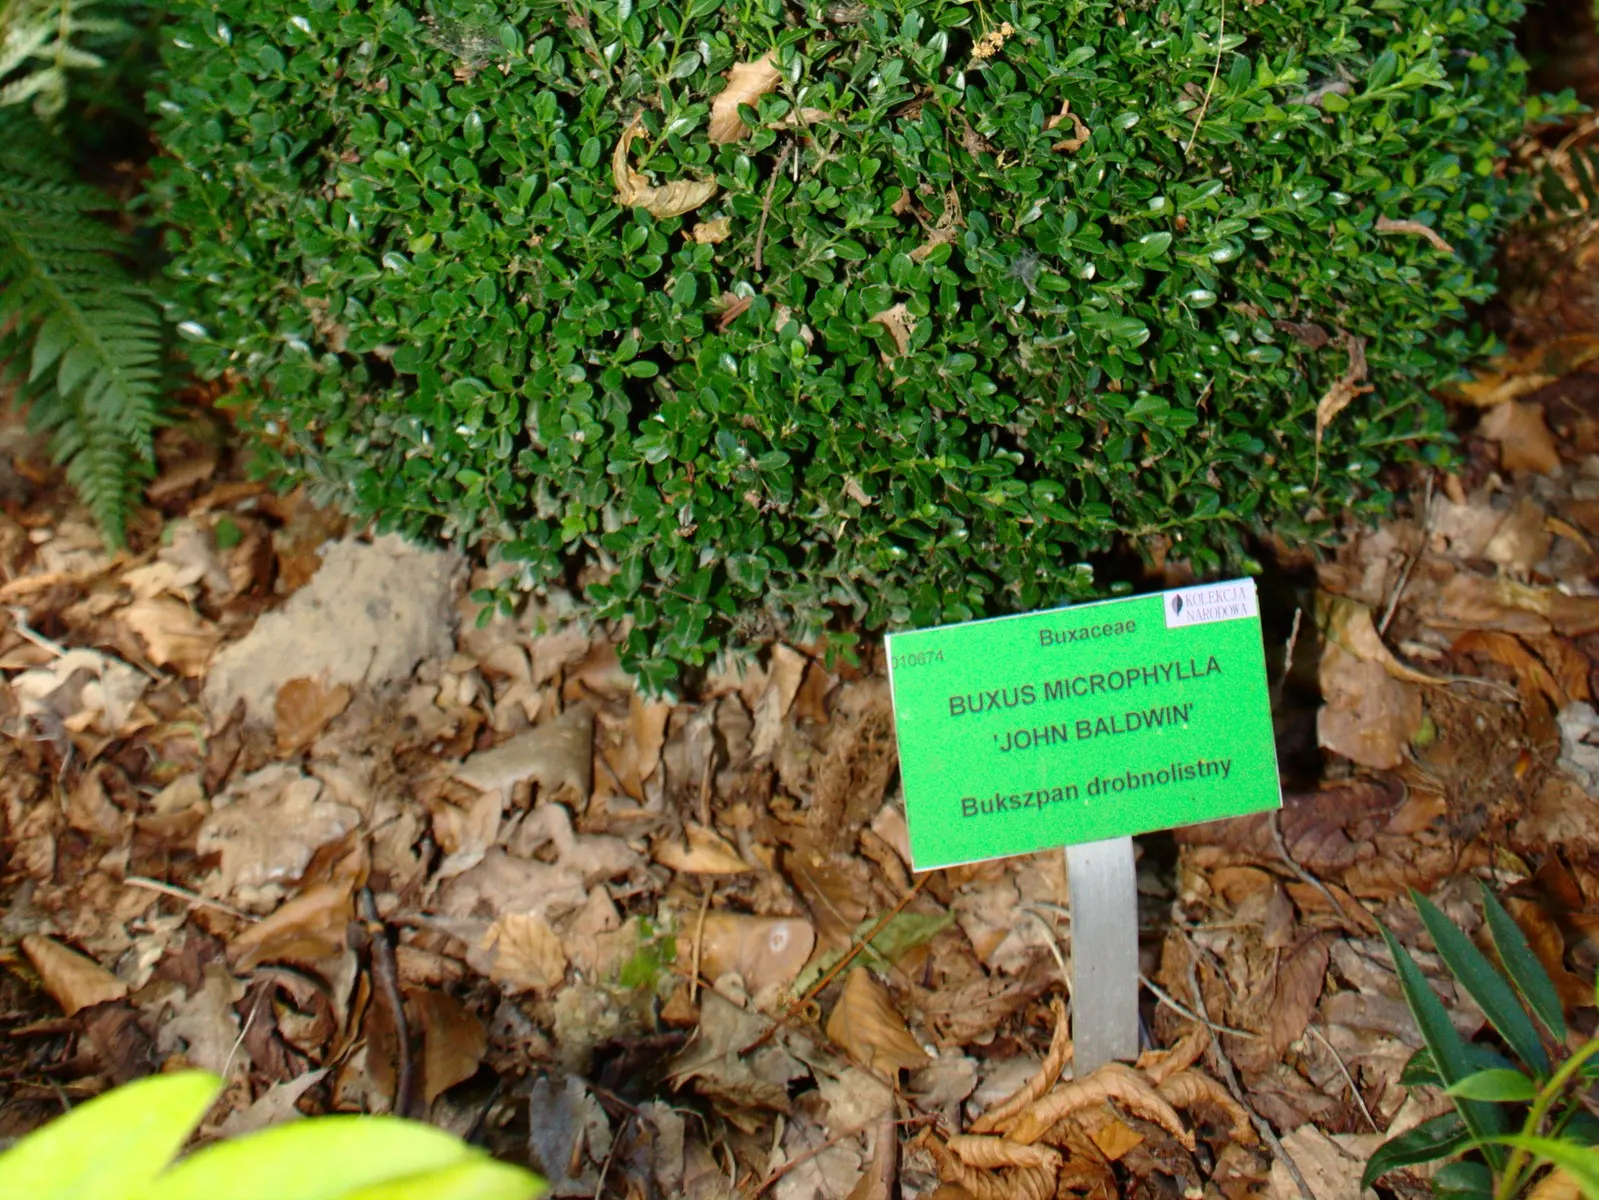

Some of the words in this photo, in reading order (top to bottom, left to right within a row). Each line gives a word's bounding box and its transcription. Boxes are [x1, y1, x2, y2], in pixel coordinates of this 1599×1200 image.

[1186, 587, 1247, 607] KOLEKCJA
[1187, 603, 1248, 622] NARODOWA
[1039, 618, 1137, 646] Buxaceae
[948, 684, 1037, 717] BUXUS
[1043, 655, 1222, 702] MICROPHYLLA
[993, 725, 1068, 753] 'JOHN
[1075, 702, 1195, 740] BALDWIN'
[961, 781, 1080, 818] Bukszpan
[1087, 757, 1232, 797] drobnolistny
